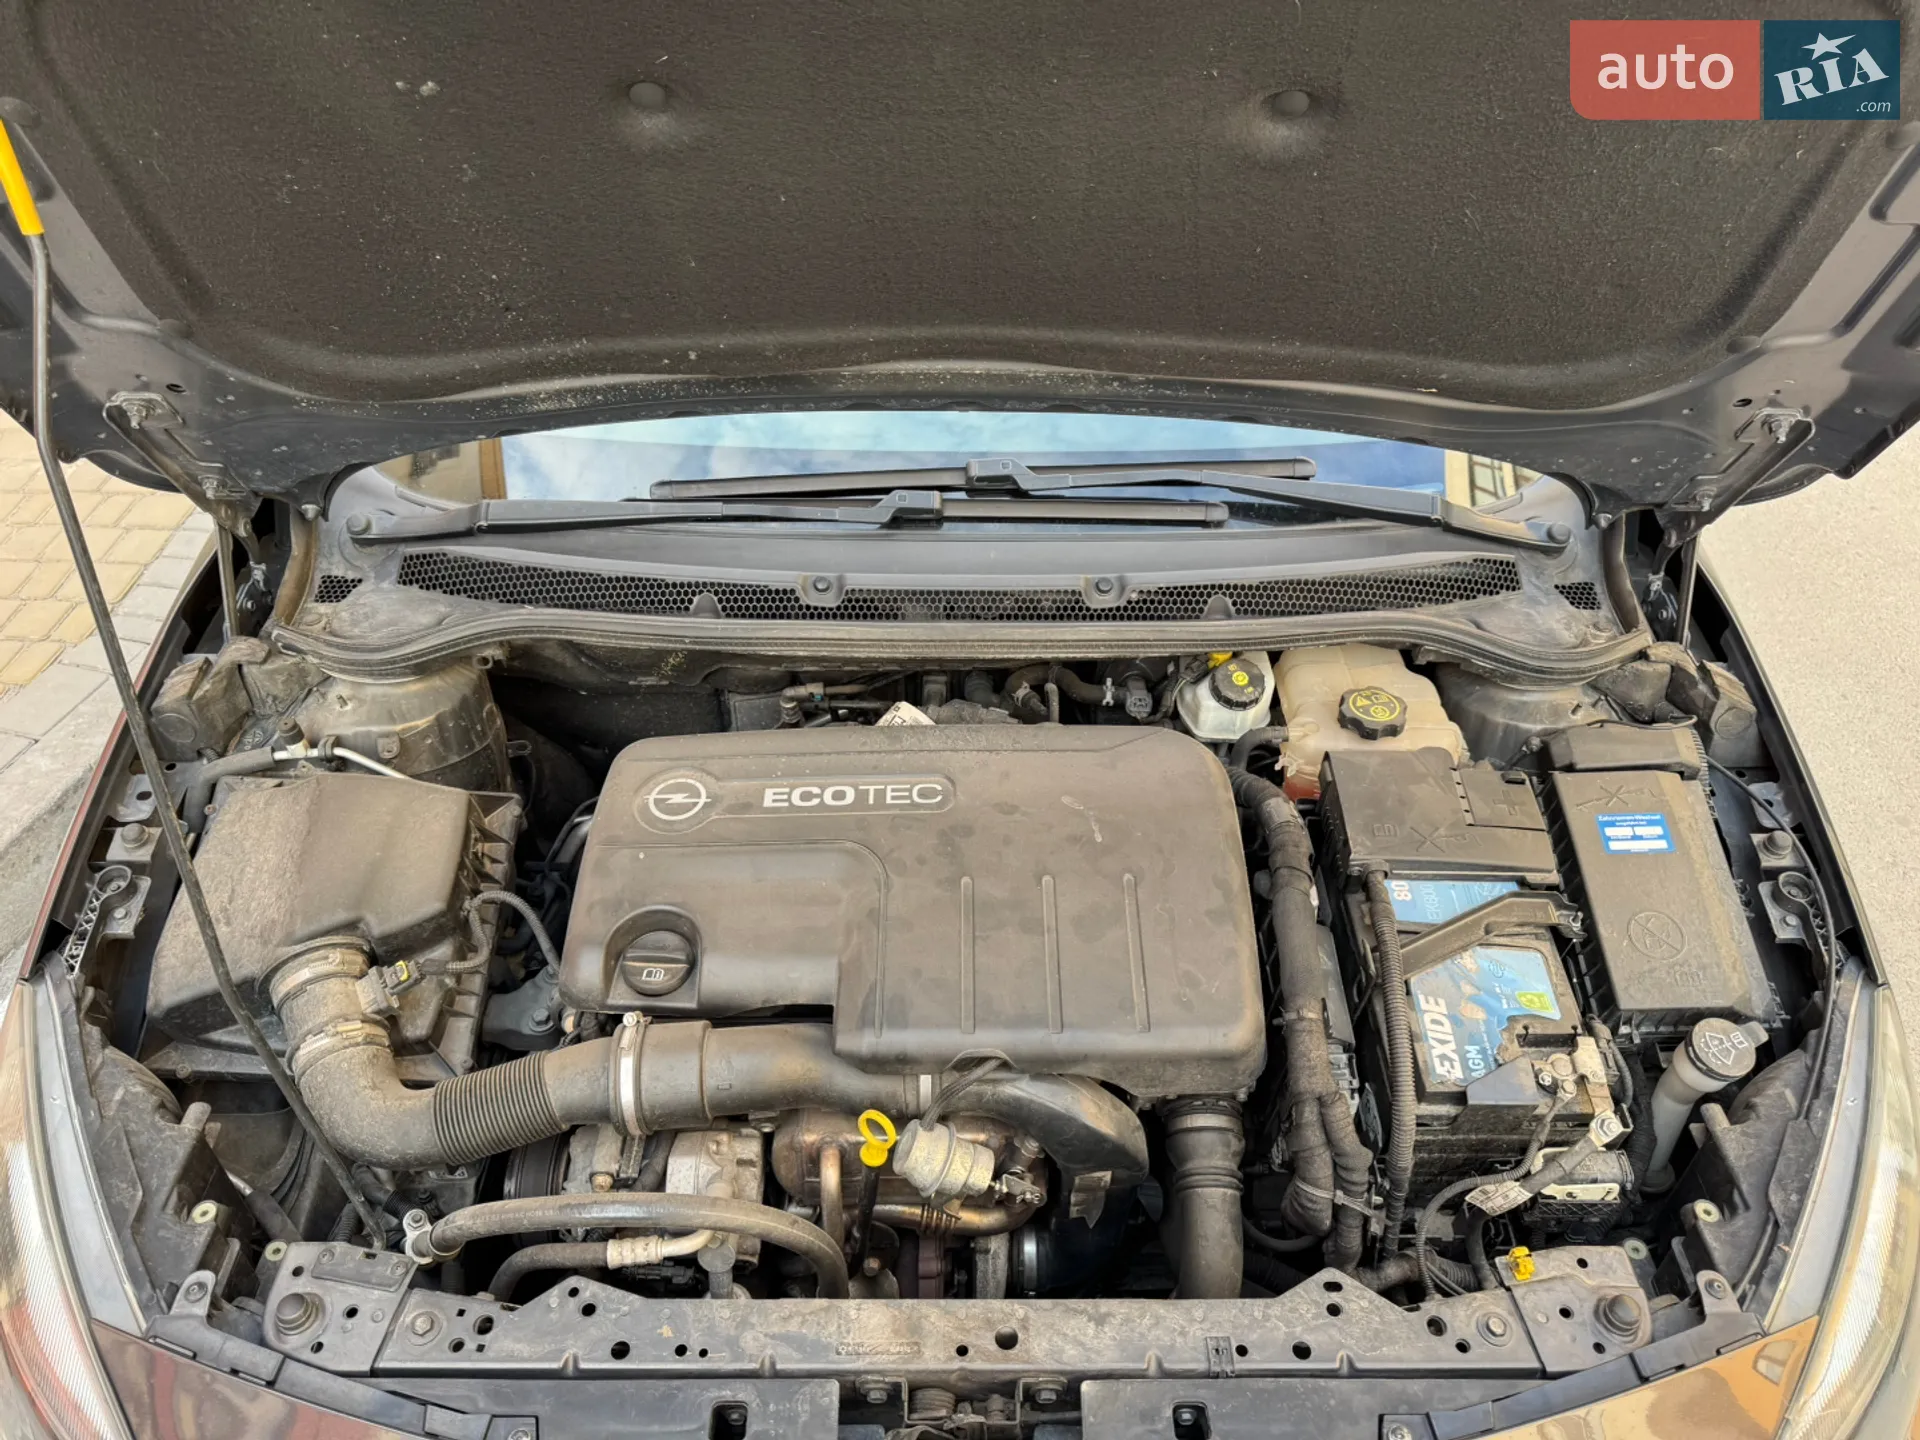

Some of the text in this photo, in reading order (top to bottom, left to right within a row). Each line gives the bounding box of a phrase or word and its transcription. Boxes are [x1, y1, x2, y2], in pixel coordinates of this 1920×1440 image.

[763, 783, 944, 808] ECOTEC
[1391, 880, 1413, 901] 80
[1418, 994, 1465, 1081] EXIDE
[1464, 1045, 1486, 1078] AGM
